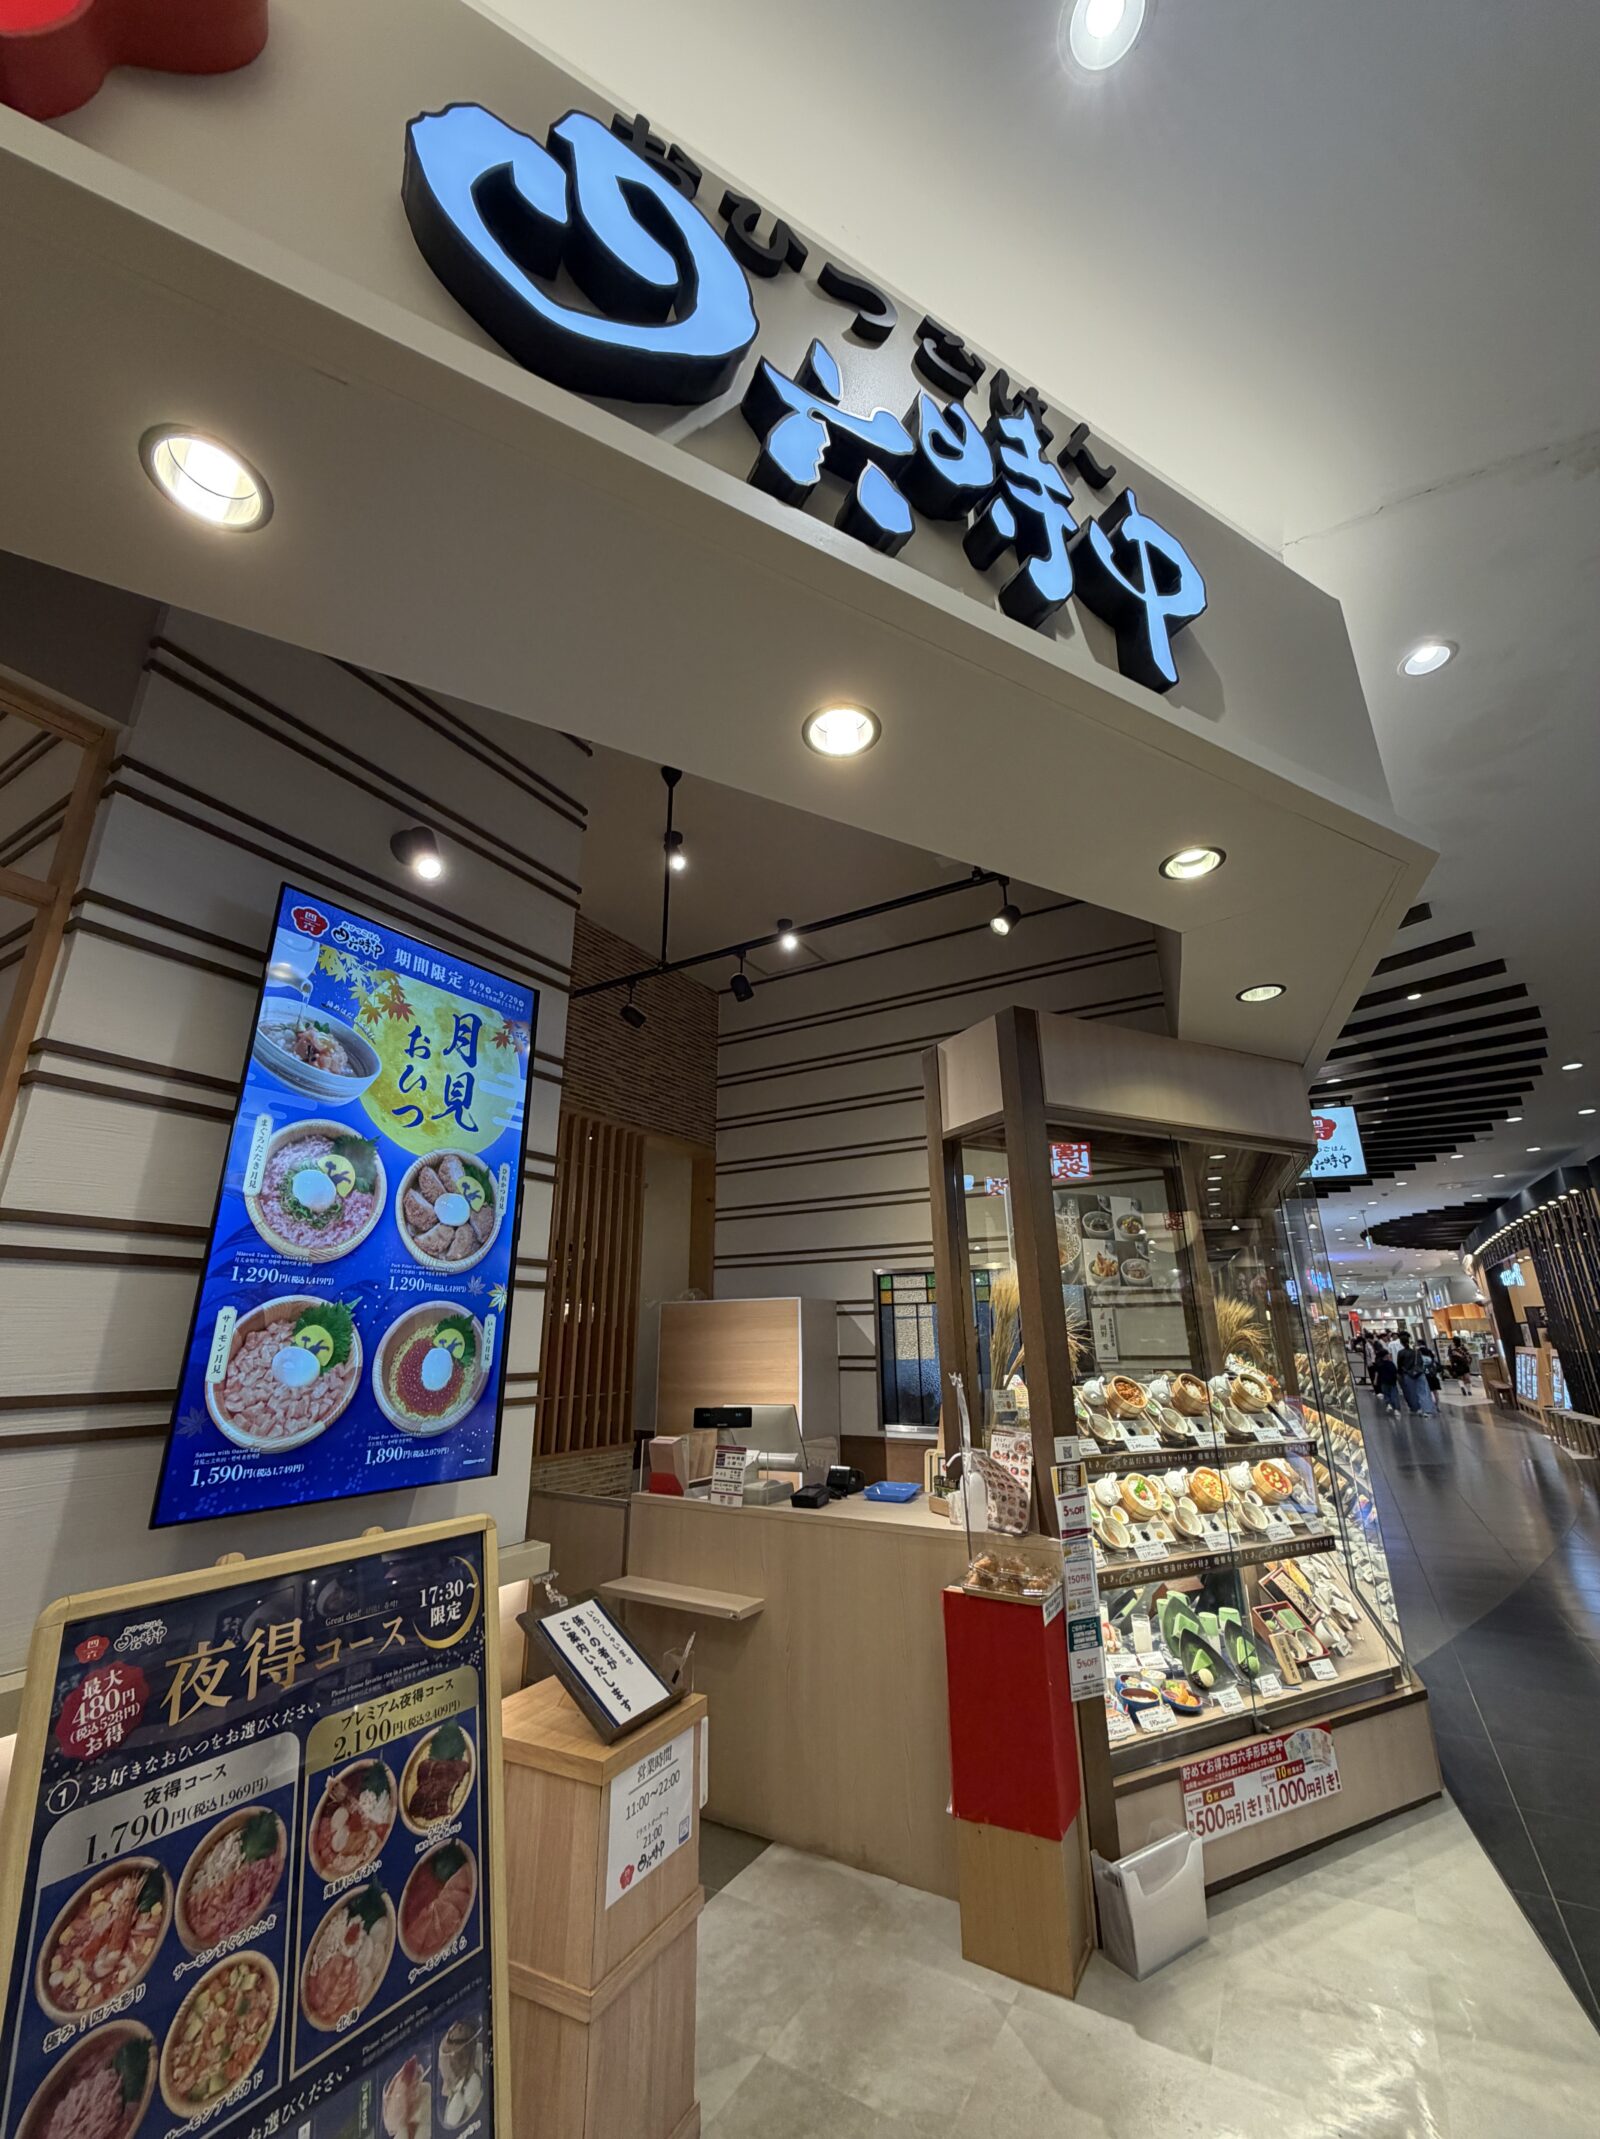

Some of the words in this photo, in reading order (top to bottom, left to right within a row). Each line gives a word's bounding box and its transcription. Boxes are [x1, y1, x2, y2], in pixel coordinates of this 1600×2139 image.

[611, 113, 1118, 490] おひつごはん
[402, 102, 1209, 692] 四六時中
[394, 947, 463, 989] 期間限定
[391, 1024, 432, 1129] おひつ
[431, 1012, 483, 1132] 月見
[250, 1117, 269, 1189] まぐろたたき月見
[211, 1313, 232, 1376] サーモン月見
[483, 1320, 494, 1362] いくら月見
[325, 1615, 345, 1627] Great
[429, 1601, 463, 1628] 限定
[586, 1610, 634, 1666] いらっしゃいませ
[87, 1639, 100, 1659] 四六
[559, 1620, 632, 1713] ご案内いたします
[571, 1614, 618, 1672] 係りの者が
[71, 1687, 136, 1728] 480円
[81, 1669, 124, 1700] 最大
[341, 1678, 455, 1731] プレミアム夜得コース
[84, 1722, 125, 1757] お得
[89, 1700, 322, 1796] お好きなおひつをお選びください
[636, 1744, 673, 1784] 営業時間
[1182, 1738, 1284, 1781] 貯めてお得な四六手形配布中
[142, 1763, 228, 1811] 夜得コース
[642, 1823, 663, 1849] 21:00
[172, 1913, 278, 1982] サーモンまぐろたたき
